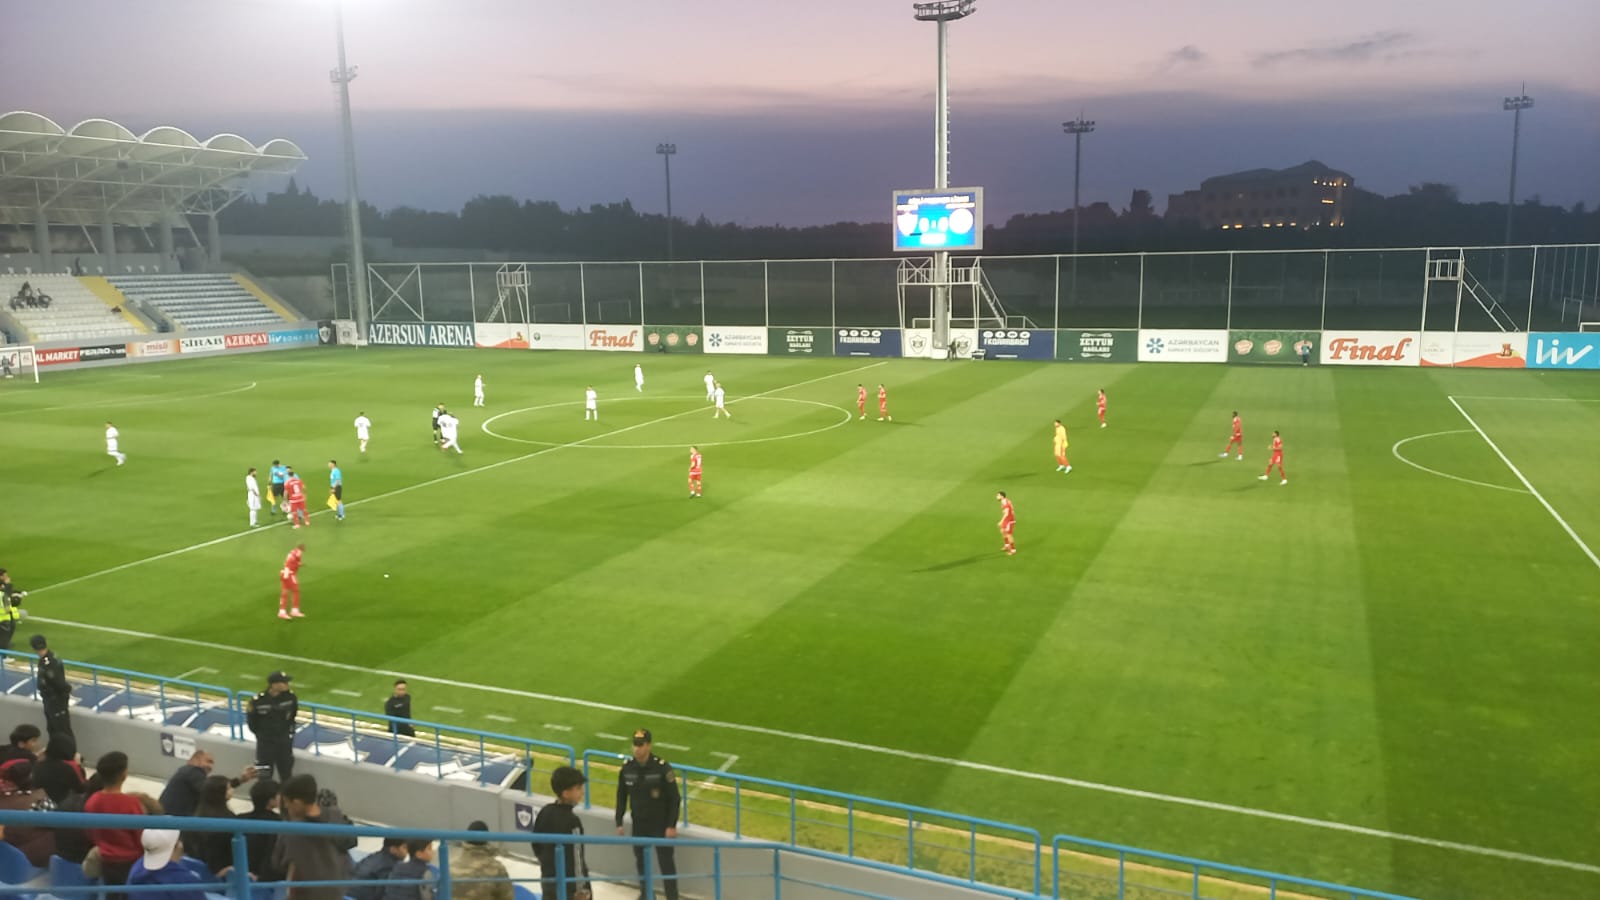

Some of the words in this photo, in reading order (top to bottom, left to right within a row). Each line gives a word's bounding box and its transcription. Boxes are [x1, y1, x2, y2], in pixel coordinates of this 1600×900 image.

[368, 323, 425, 345] AZERSUN
[429, 324, 474, 346] ARENA
[589, 329, 638, 348] Final
[45, 350, 79, 362] MARKET
[1328, 337, 1413, 361] Final
[1535, 338, 1594, 365] liv
